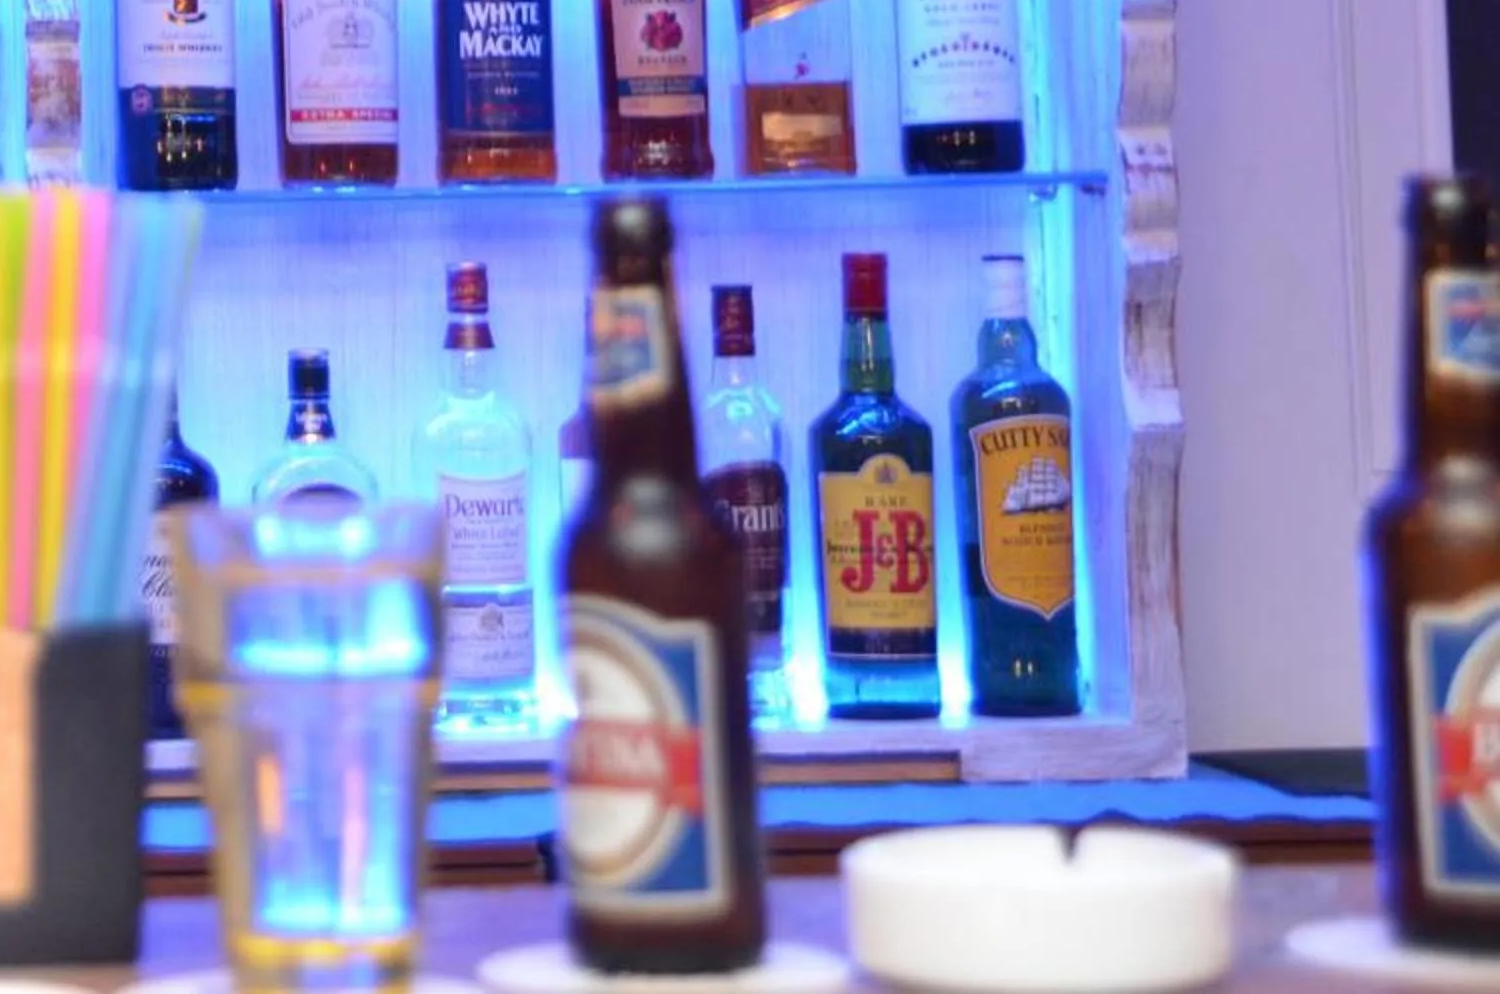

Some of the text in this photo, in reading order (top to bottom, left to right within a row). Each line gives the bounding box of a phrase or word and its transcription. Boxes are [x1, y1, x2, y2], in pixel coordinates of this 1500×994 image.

[463, 1, 540, 30] WHYTE
[459, 29, 544, 60] MACKAY
[979, 425, 1045, 456] CUTTY
